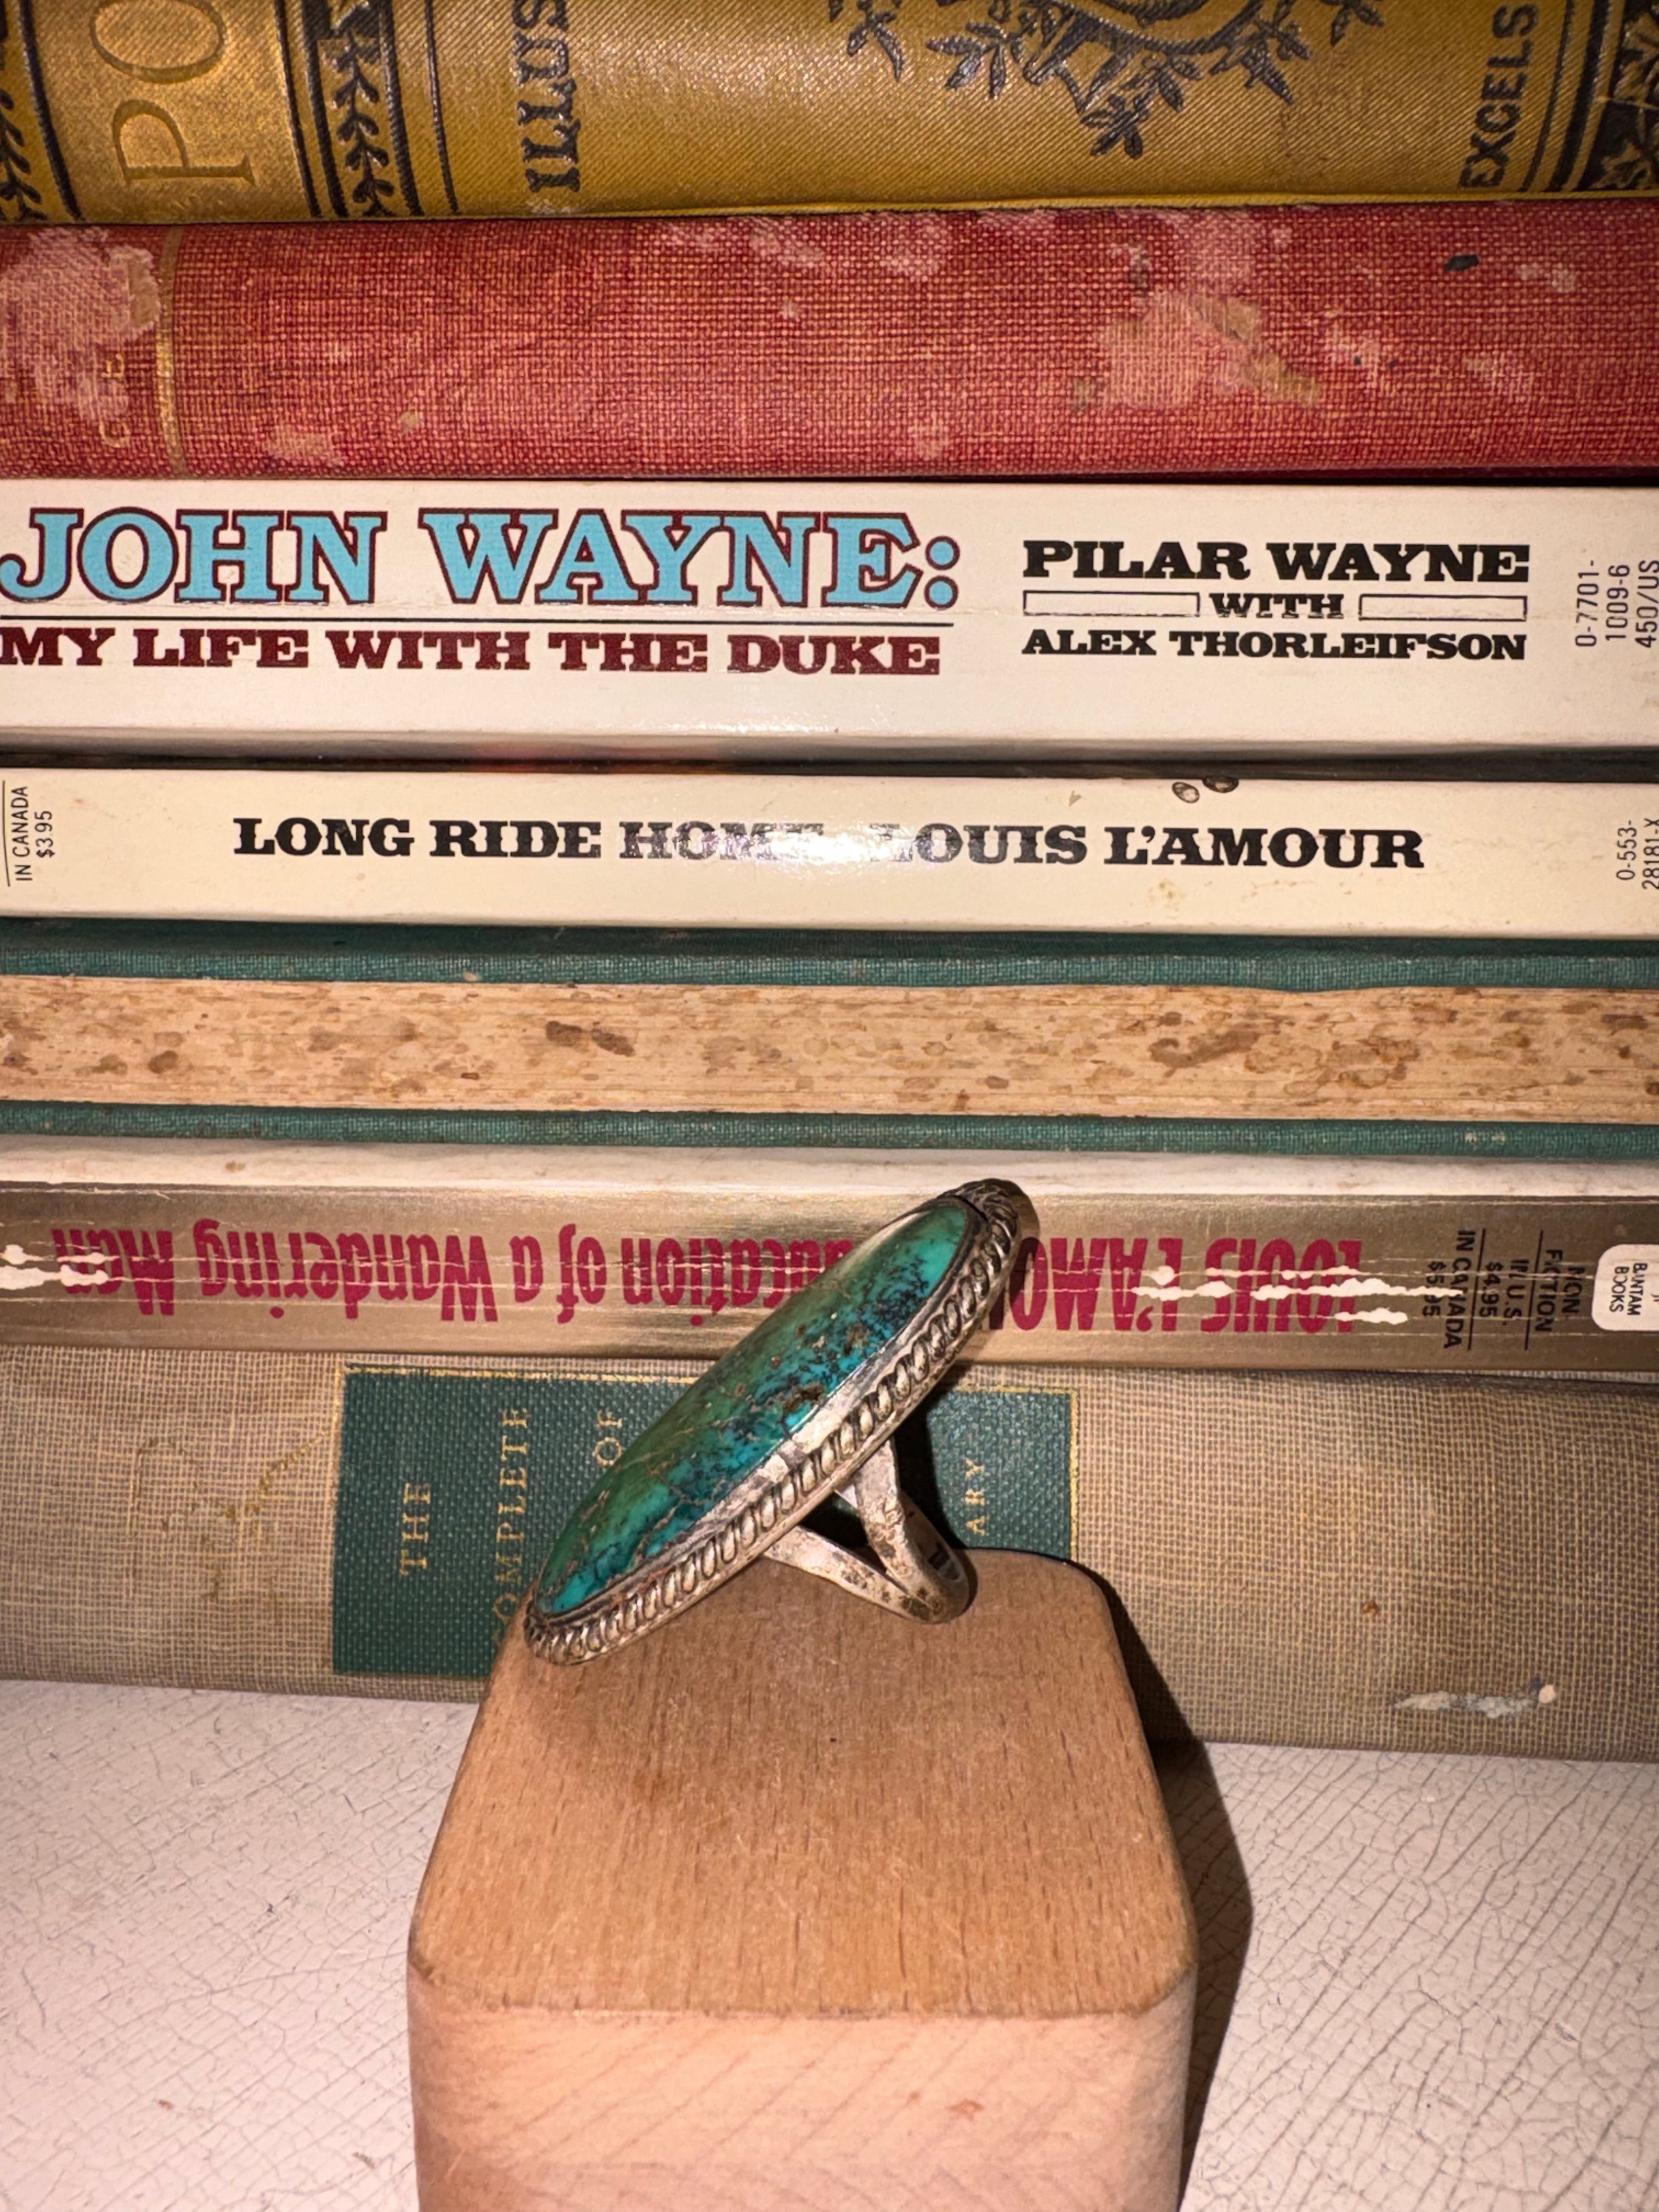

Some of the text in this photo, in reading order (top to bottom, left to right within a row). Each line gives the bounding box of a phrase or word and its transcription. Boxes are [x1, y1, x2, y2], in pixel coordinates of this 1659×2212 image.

[0, 506, 961, 611] JOHN WAYNE:
[1022, 539, 1531, 583] PILAR WAYNE
[1208, 591, 1345, 619] WITH
[1604, 564, 1630, 641] 1009-6
[0, 627, 940, 675] MY LIFE WITH THE DUKE
[1022, 629, 1527, 661] ALEX THORLEIFSON
[10, 786, 33, 882] IN CANADA
[233, 817, 415, 856] LONG
[430, 820, 602, 859] RIDE
[1104, 826, 1425, 868] L'AMOUR
[1616, 820, 1637, 881] 0-553-
[52, 1228, 174, 1316] Man
[193, 1218, 499, 1323] Wandering
[509, 1235, 544, 1302] a
[556, 1223, 606, 1324] of
[1201, 1238, 1362, 1333] LOUIS
[1443, 1229, 1476, 1349] IN CANADA
[1479, 1262, 1504, 1317] $4.95
[1508, 1260, 1530, 1278] IN
[592, 1408, 624, 1466] OF
[399, 1482, 432, 1577] THE
[490, 1408, 531, 1647] OMPLETE
